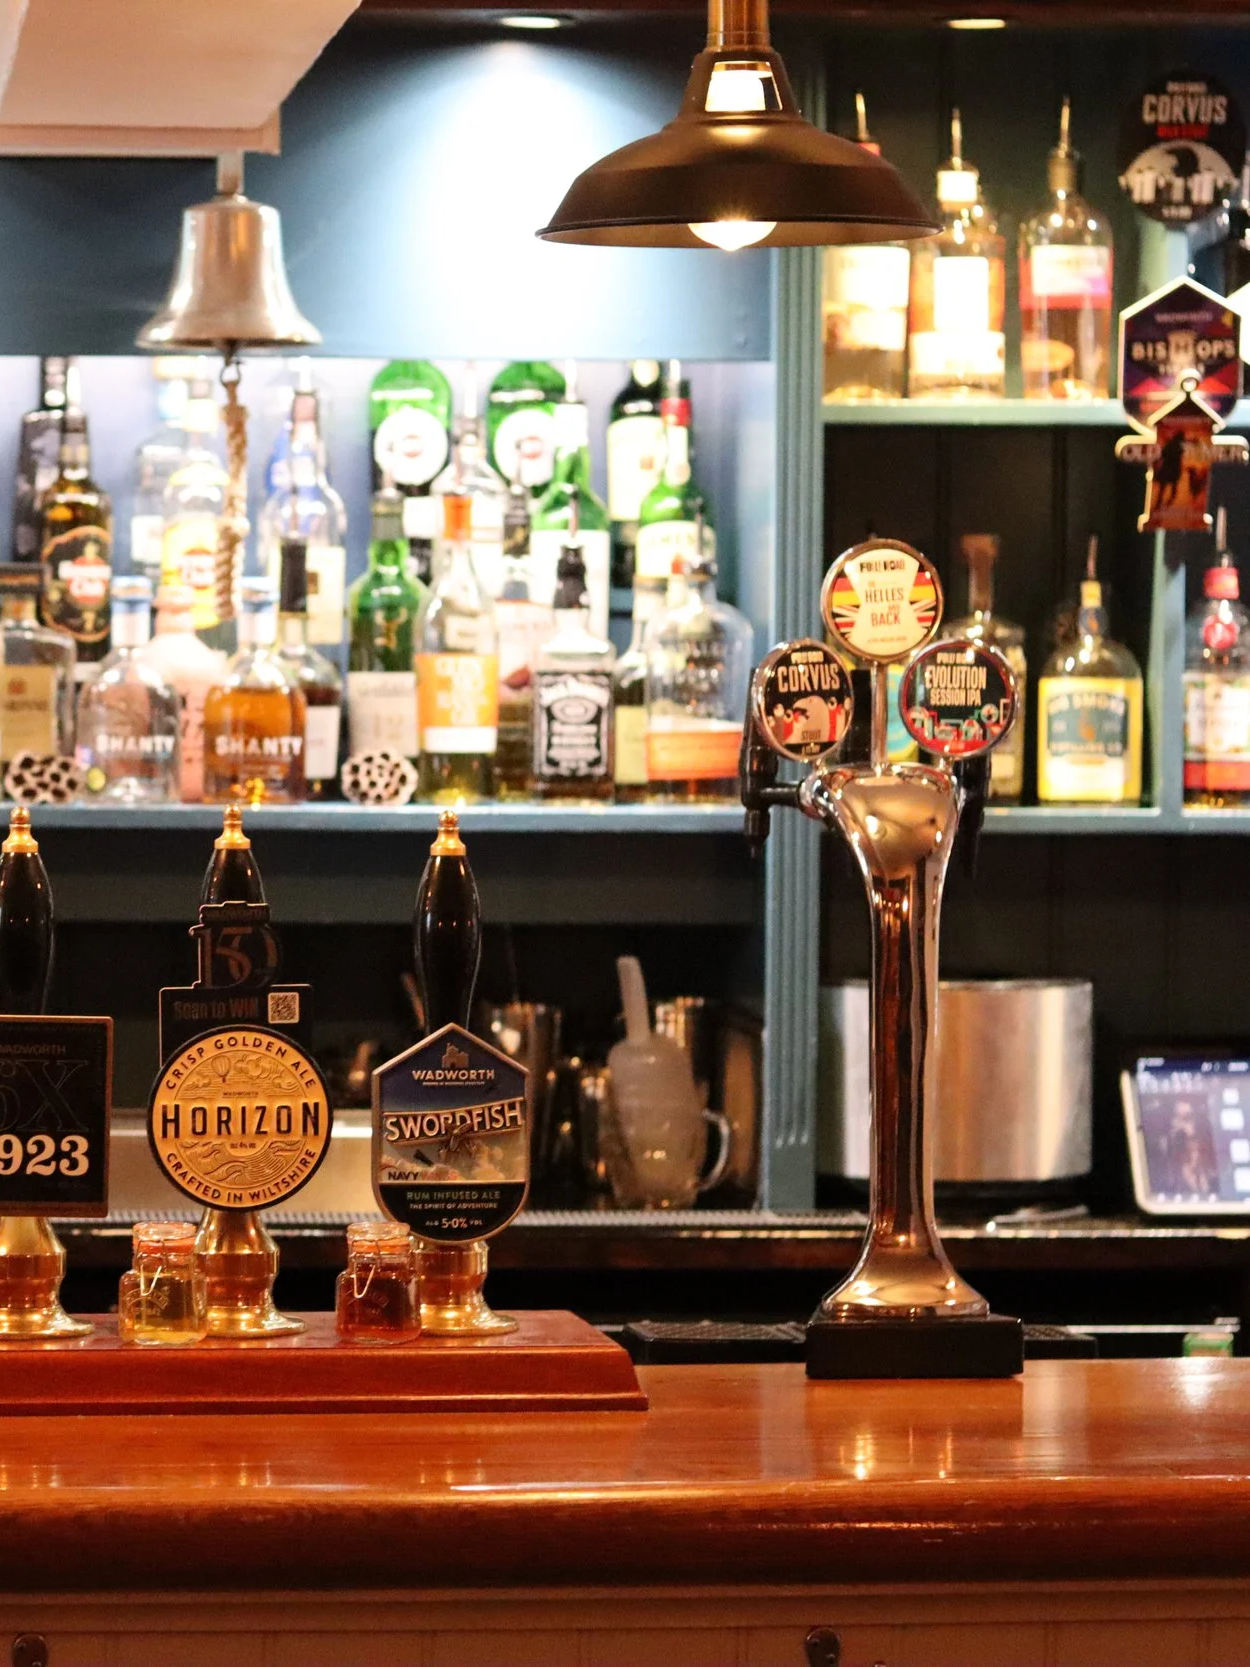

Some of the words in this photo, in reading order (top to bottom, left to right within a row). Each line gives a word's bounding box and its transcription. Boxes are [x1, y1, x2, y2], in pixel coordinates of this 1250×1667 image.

[1142, 94, 1228, 124] CORVUS
[865, 587, 904, 603] HELLES
[871, 612, 901, 627] BACK
[777, 664, 840, 693] CORVUS
[925, 665, 987, 690] EVOLUTION
[930, 688, 966, 706] SESSION
[967, 688, 982, 706] IPA
[96, 733, 175, 753] SHANTY
[215, 735, 303, 756] SHANTY
[229, 997, 259, 1019] WIN
[165, 1047, 206, 1090] CRISP
[214, 1036, 287, 1059] GOLDEN
[291, 1060, 317, 1089] ALE
[412, 1069, 495, 1081] WADWORTH
[161, 1101, 320, 1139] HORIZON
[384, 1101, 523, 1141] SWORDFISH
[166, 1153, 221, 1199] CRAFTED
[227, 1191, 242, 1203] IN
[249, 1148, 316, 1201] WILTSHIRE
[388, 1171, 419, 1181] NAVY
[406, 1191, 430, 1200] RUM
[433, 1191, 479, 1200] INFUSED
[481, 1190, 501, 1199] ALE
